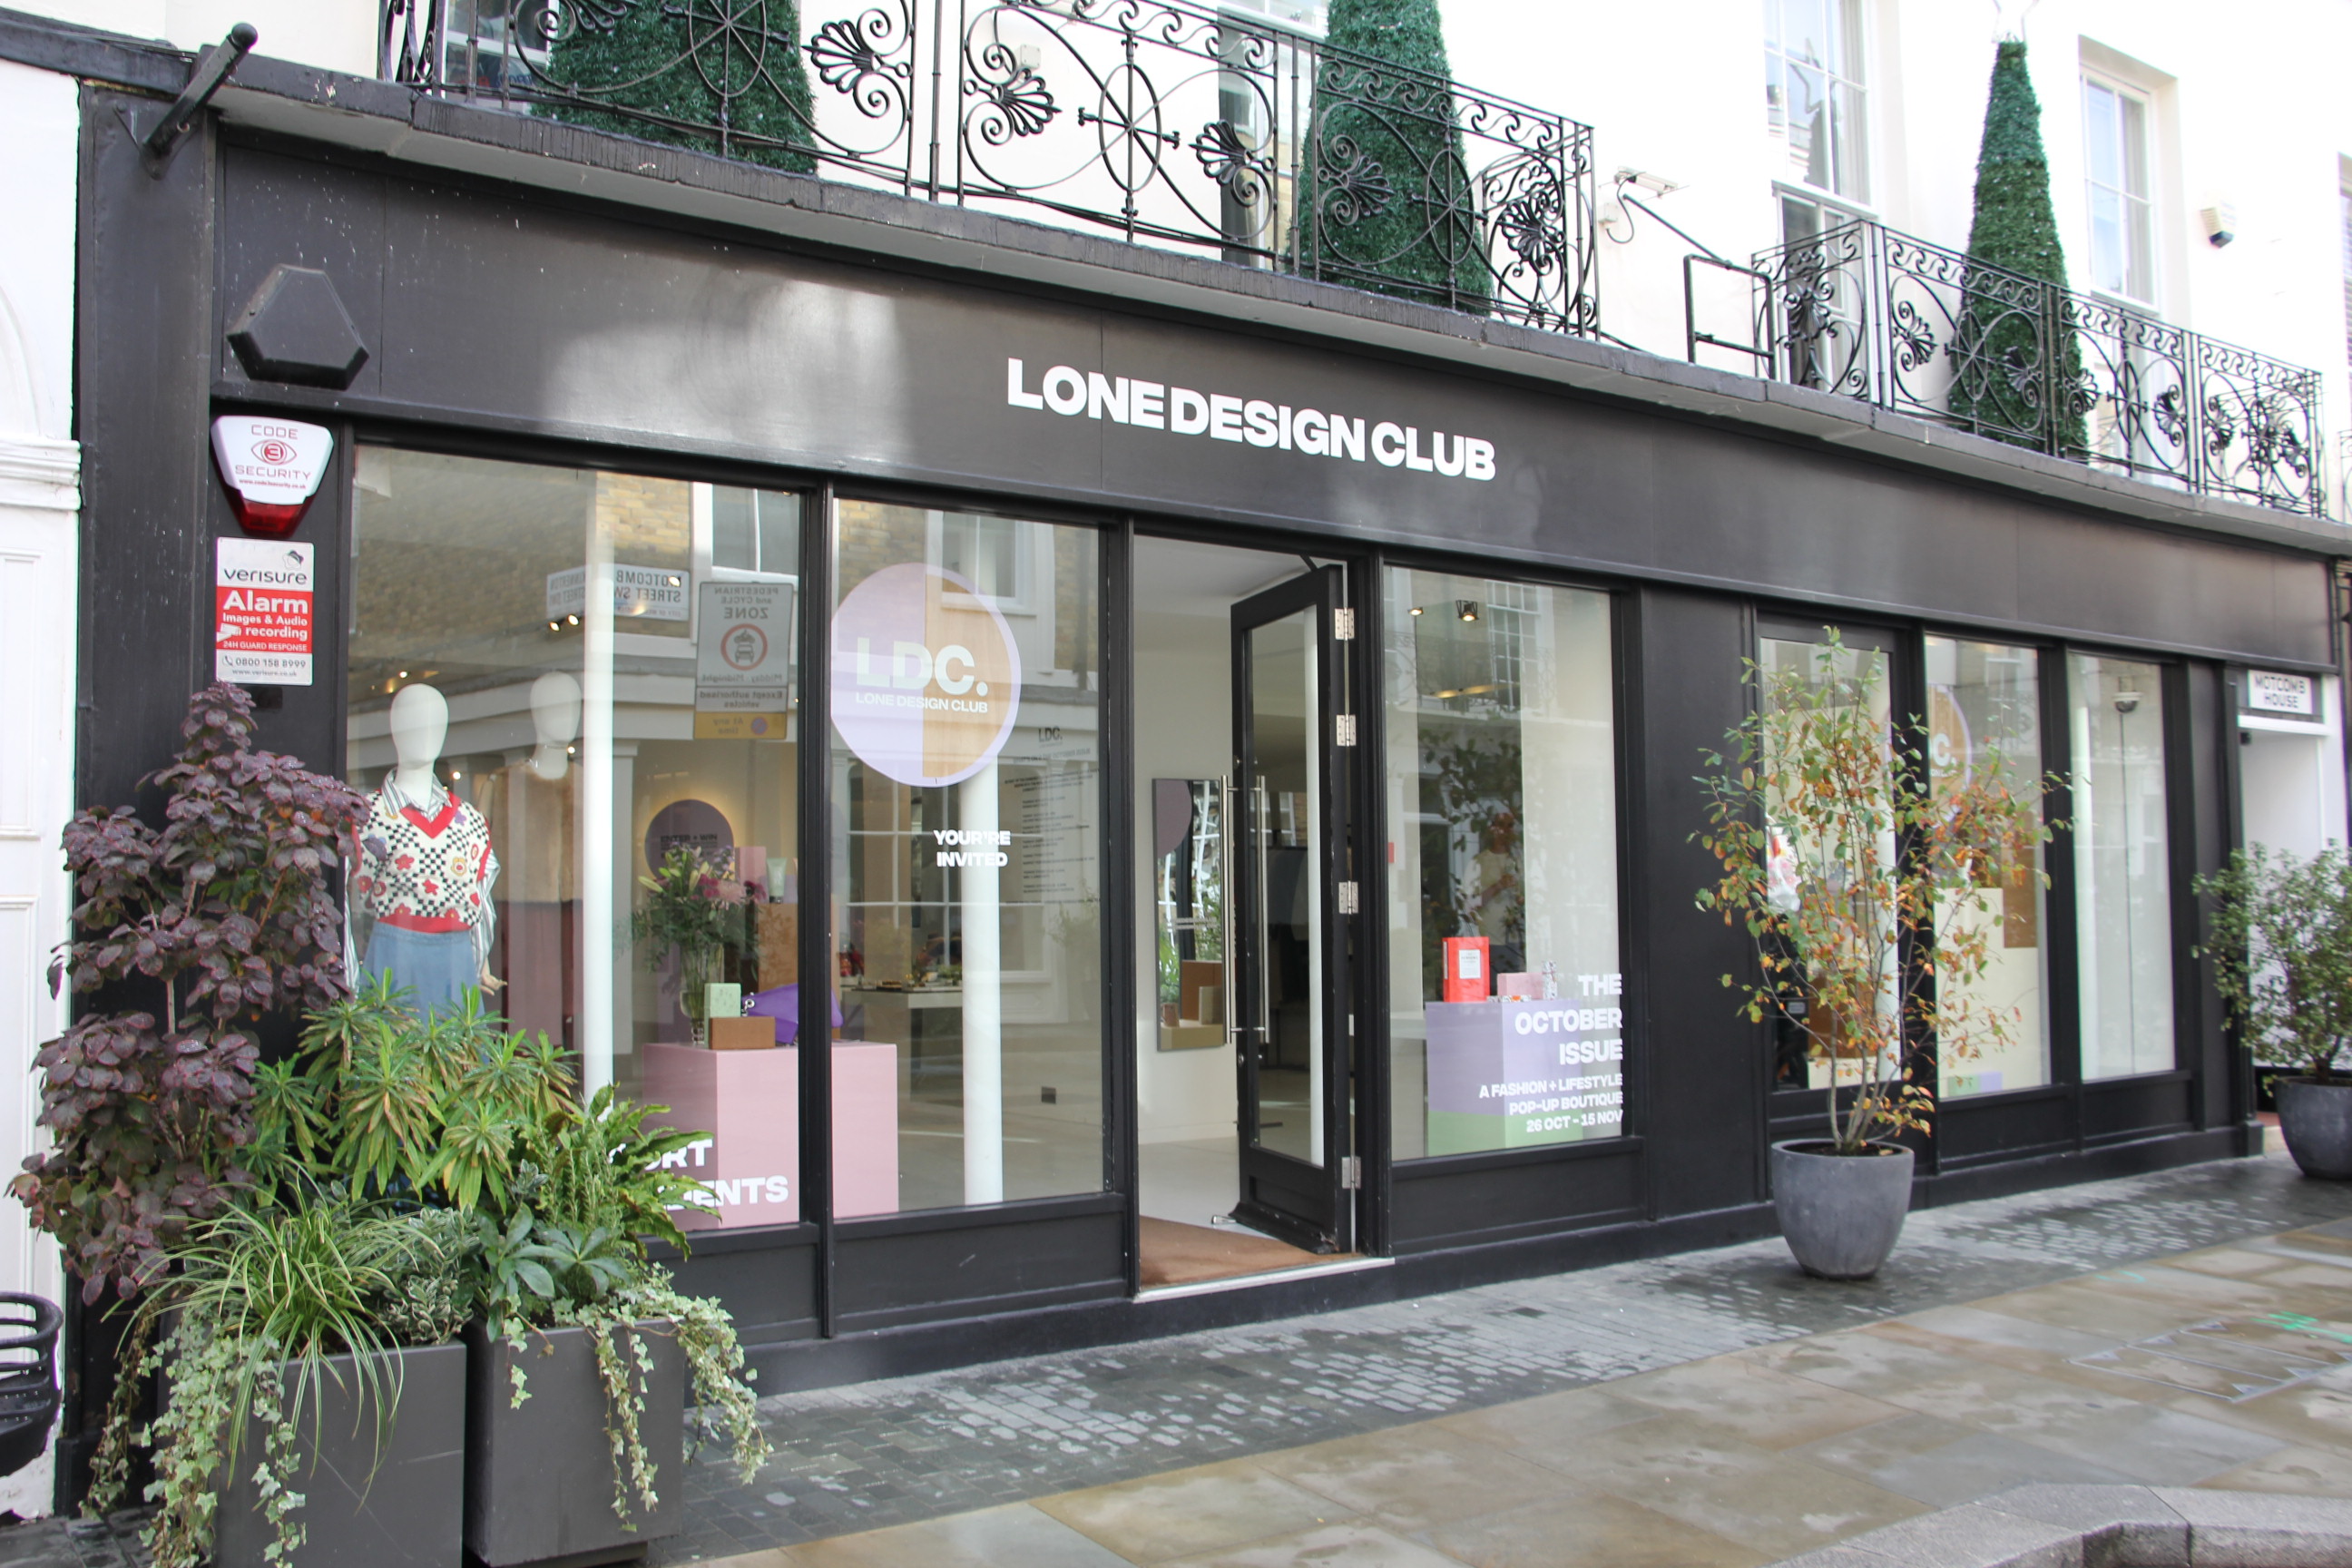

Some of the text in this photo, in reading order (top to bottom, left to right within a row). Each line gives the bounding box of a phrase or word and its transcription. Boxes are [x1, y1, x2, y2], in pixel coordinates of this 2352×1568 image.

[1007, 357, 1496, 482] LONE DESIGN CLUB
[250, 424, 299, 440] CODE
[235, 465, 311, 481] SECURITY
[223, 568, 308, 585] verisure
[223, 589, 309, 614] Alarm
[222, 612, 309, 627] Images & Audio
[245, 625, 309, 642] recording
[222, 640, 308, 652] 24H GUARD RESPONSE
[235, 657, 307, 669] 0800 158 8999
[857, 637, 988, 697] LDC.
[2255, 674, 2306, 694] MOTCOMB
[856, 691, 988, 714] LONE DESIGN CLUB
[2264, 691, 2298, 709] HOUSE
[1038, 727, 1063, 743] LDC.
[933, 829, 1012, 846] YOUR'RE
[936, 851, 1008, 867] INVITED
[1578, 973, 1622, 997] THE
[1514, 1007, 1623, 1035] OCTOBER
[1559, 1038, 1623, 1065] ISSUE
[1479, 1084, 1490, 1099] A
[1491, 1080, 1548, 1098] FASHION
[1558, 1073, 1623, 1093] LIFESTYLE
[1509, 1091, 1623, 1116] POP-UP BOUTIQUE
[1526, 1119, 1543, 1133] 26
[1544, 1115, 1571, 1132] OCT
[1581, 1113, 1596, 1127] 15
[1597, 1109, 1623, 1125] NOV
